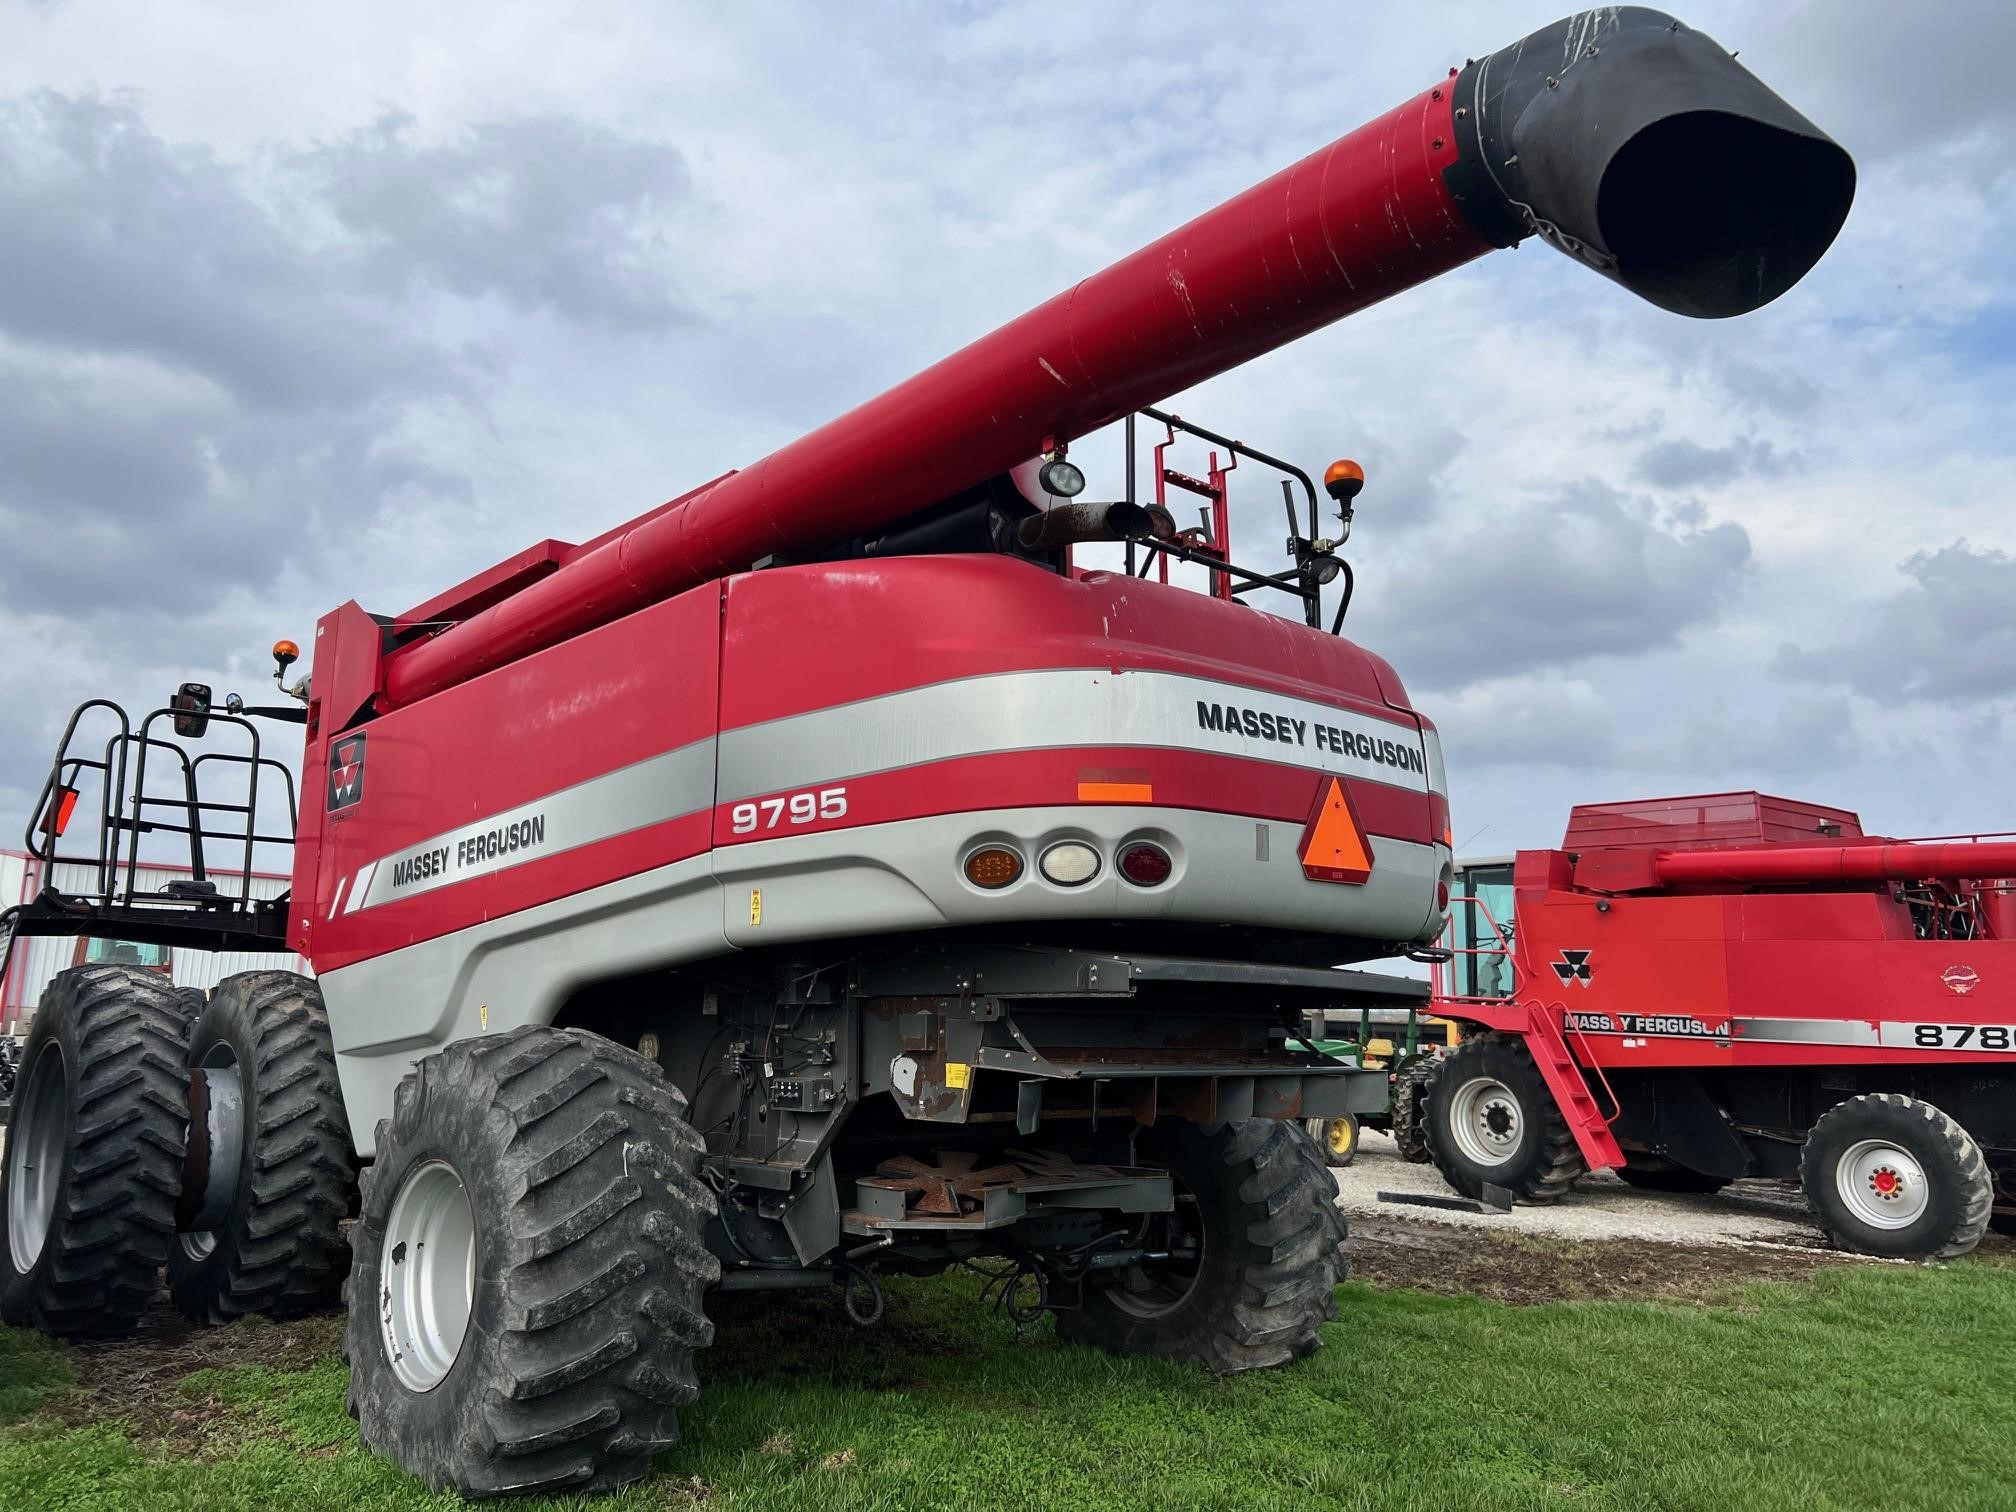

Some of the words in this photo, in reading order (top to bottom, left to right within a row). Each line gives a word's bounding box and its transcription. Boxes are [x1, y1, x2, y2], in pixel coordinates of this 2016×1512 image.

[1196, 700, 1307, 747] MASSEY
[1313, 723, 1424, 775] FERGUSON
[732, 787, 848, 834] 9795
[393, 845, 450, 888] MASSEY
[457, 814, 545, 869] FERGUSON
[1914, 1025, 2016, 1050] 878
